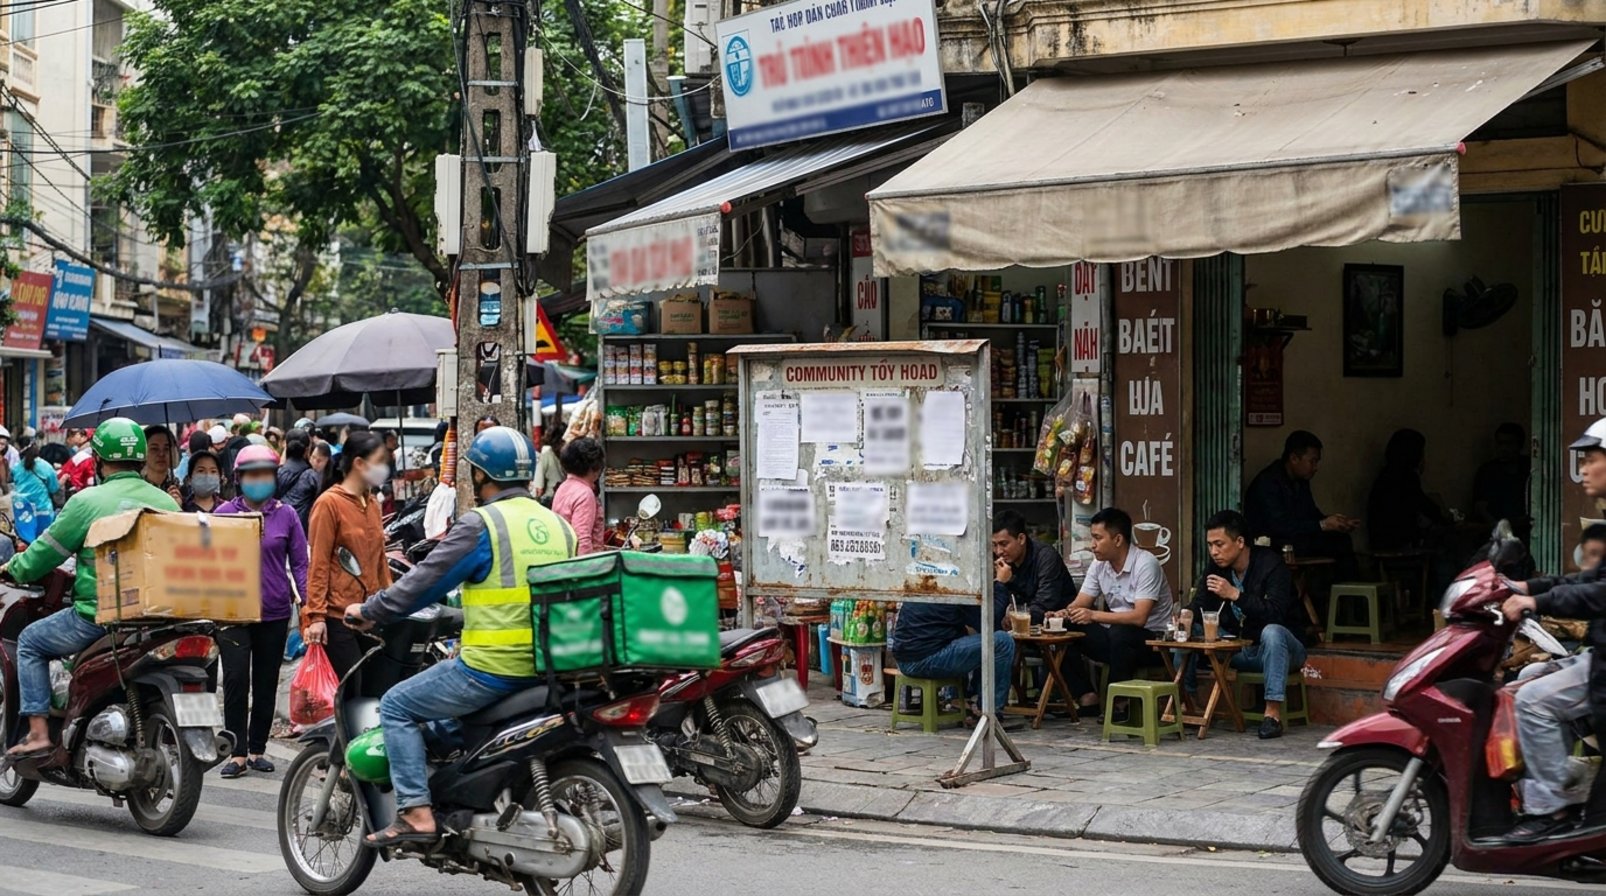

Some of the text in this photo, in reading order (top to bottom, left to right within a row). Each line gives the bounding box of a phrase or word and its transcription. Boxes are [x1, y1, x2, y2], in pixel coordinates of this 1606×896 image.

[786, 365, 867, 382] COMMUNITY
[900, 364, 938, 381] HOAD
[1120, 432, 1173, 476] CAFÉ
